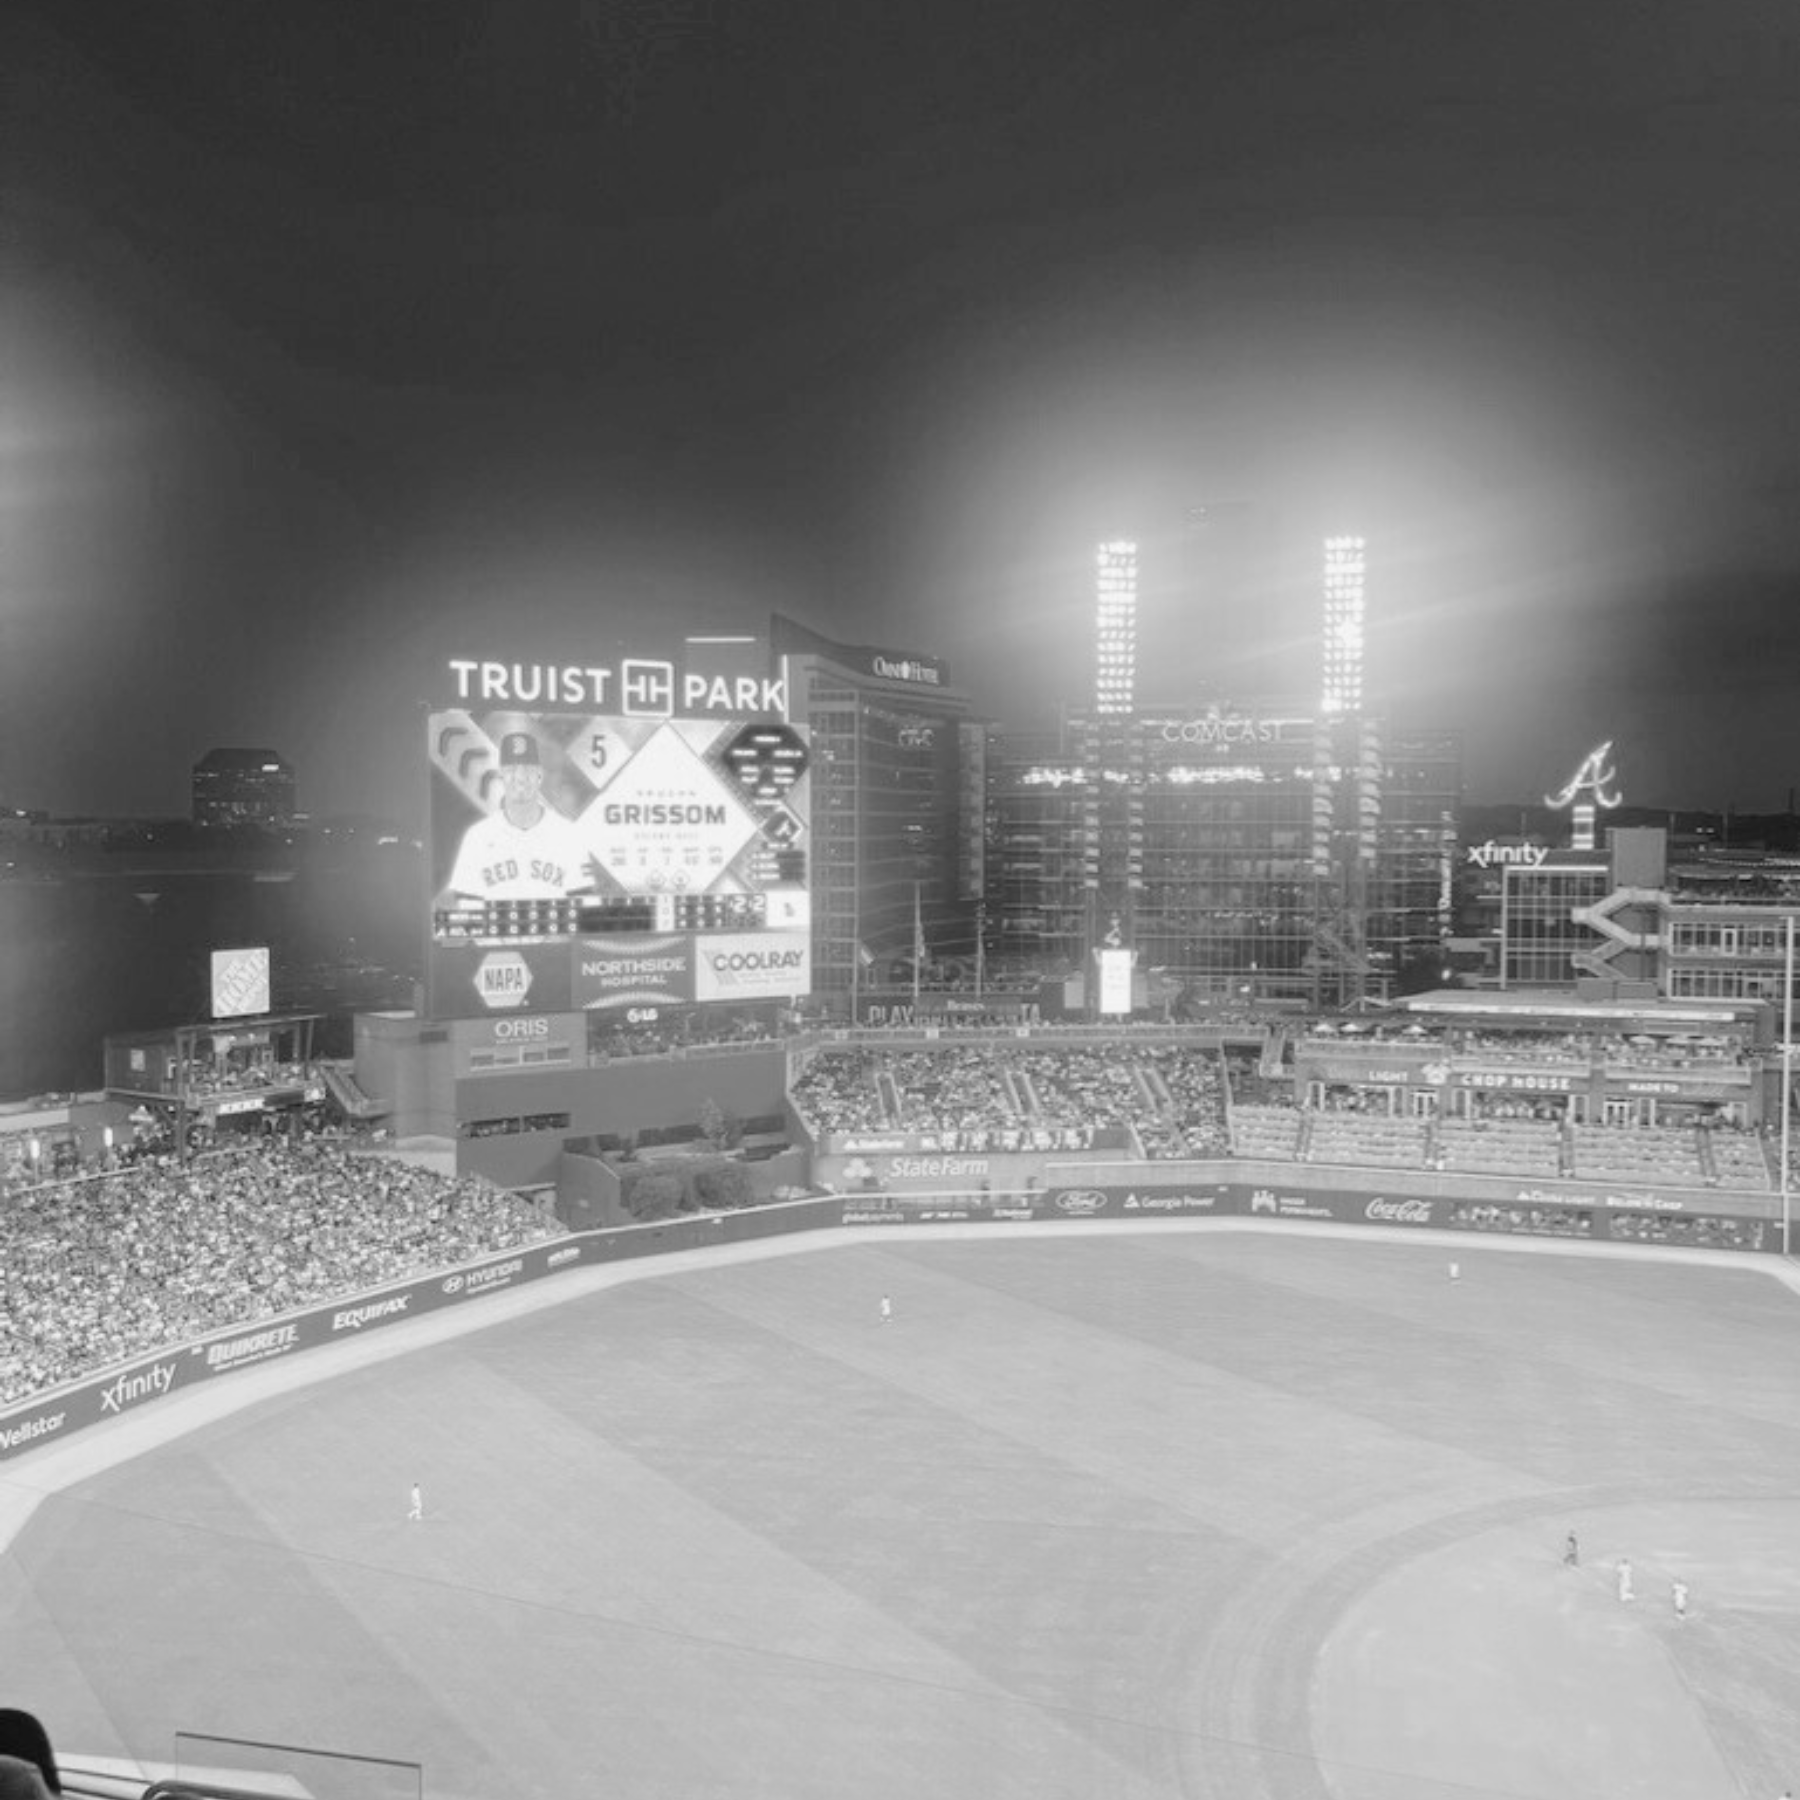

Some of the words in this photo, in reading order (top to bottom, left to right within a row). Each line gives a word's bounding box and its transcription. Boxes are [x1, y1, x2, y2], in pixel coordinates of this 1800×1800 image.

[449, 660, 611, 704] TRUIST
[684, 675, 786, 711] PARK
[1161, 722, 1283, 743] COMCAST
[591, 734, 607, 769] 5
[604, 803, 727, 825] GRISSOM
[1467, 839, 1549, 869] xfinity
[482, 859, 518, 888] RED
[530, 859, 565, 888] SOX
[582, 956, 687, 977] NORTHSIDE
[713, 950, 804, 972] COOLRAY
[484, 967, 522, 991] NAPA
[601, 974, 667, 988] HOSPITAL
[495, 1019, 548, 1037] ORIS
[1460, 1074, 1506, 1086] CHOP
[1511, 1077, 1570, 1090] HOUSE
[890, 1157, 940, 1178] State
[940, 1156, 989, 1176] Farm
[467, 1259, 523, 1287] HYUNDAI
[333, 1298, 408, 1330] EQUIFAX
[207, 1324, 298, 1365] QUIKRETE
[100, 1363, 176, 1412] xfinity
